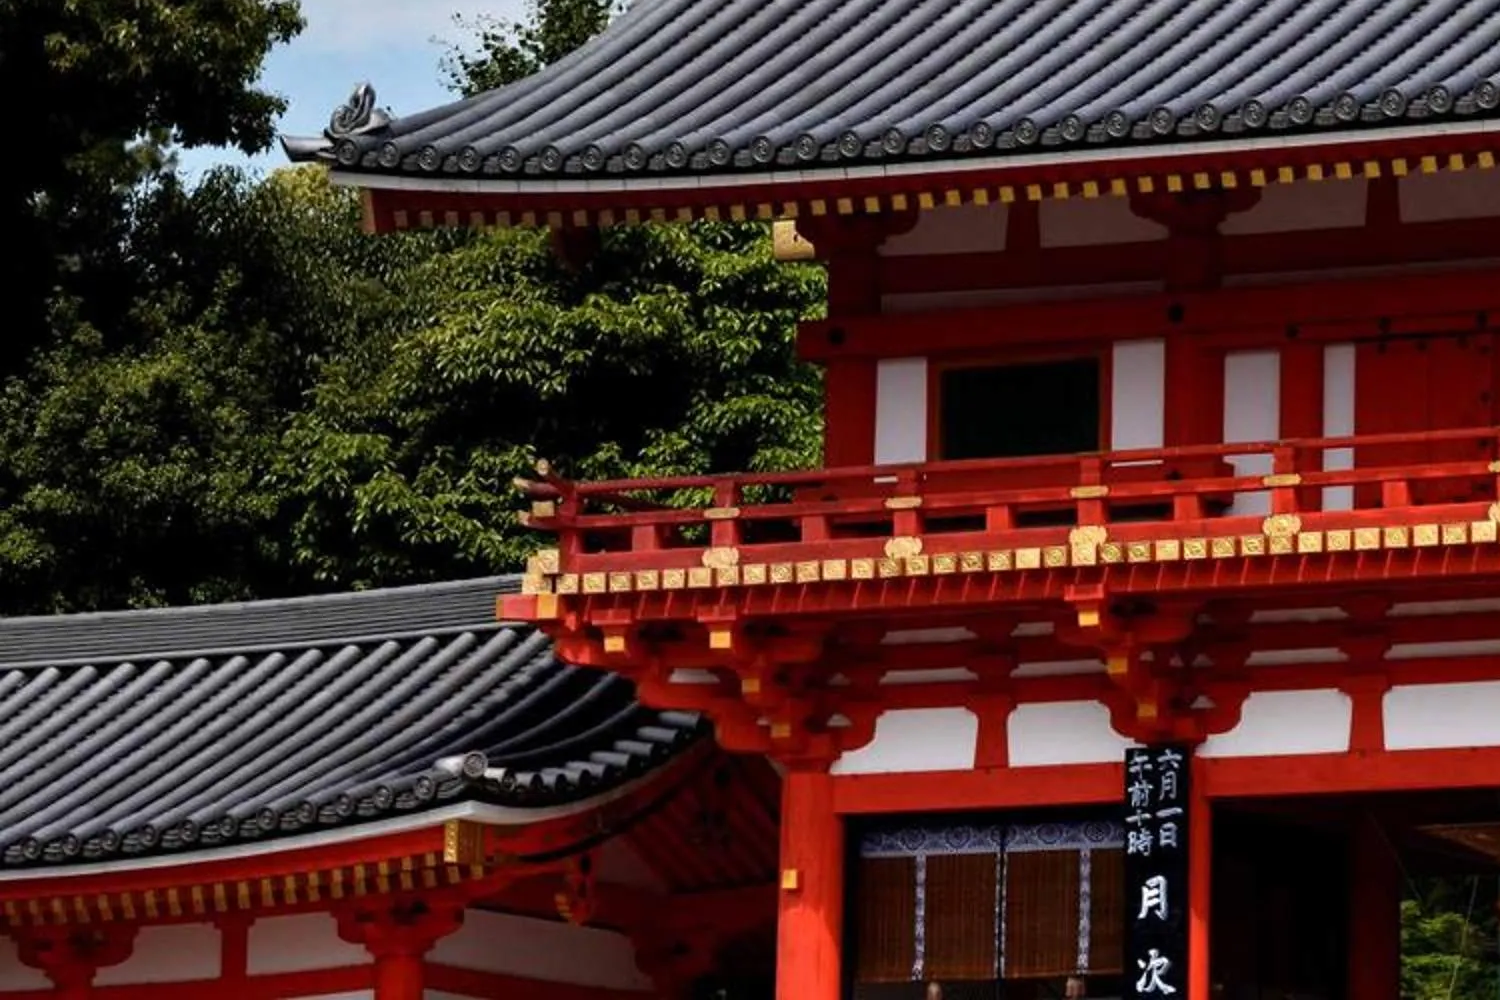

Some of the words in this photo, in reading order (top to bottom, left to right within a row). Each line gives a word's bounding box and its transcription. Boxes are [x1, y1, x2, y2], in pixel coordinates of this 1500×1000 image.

[1125, 751, 1153, 857] 午前十時
[1156, 749, 1184, 848] 六月一日
[1137, 875, 1177, 995] 月次
